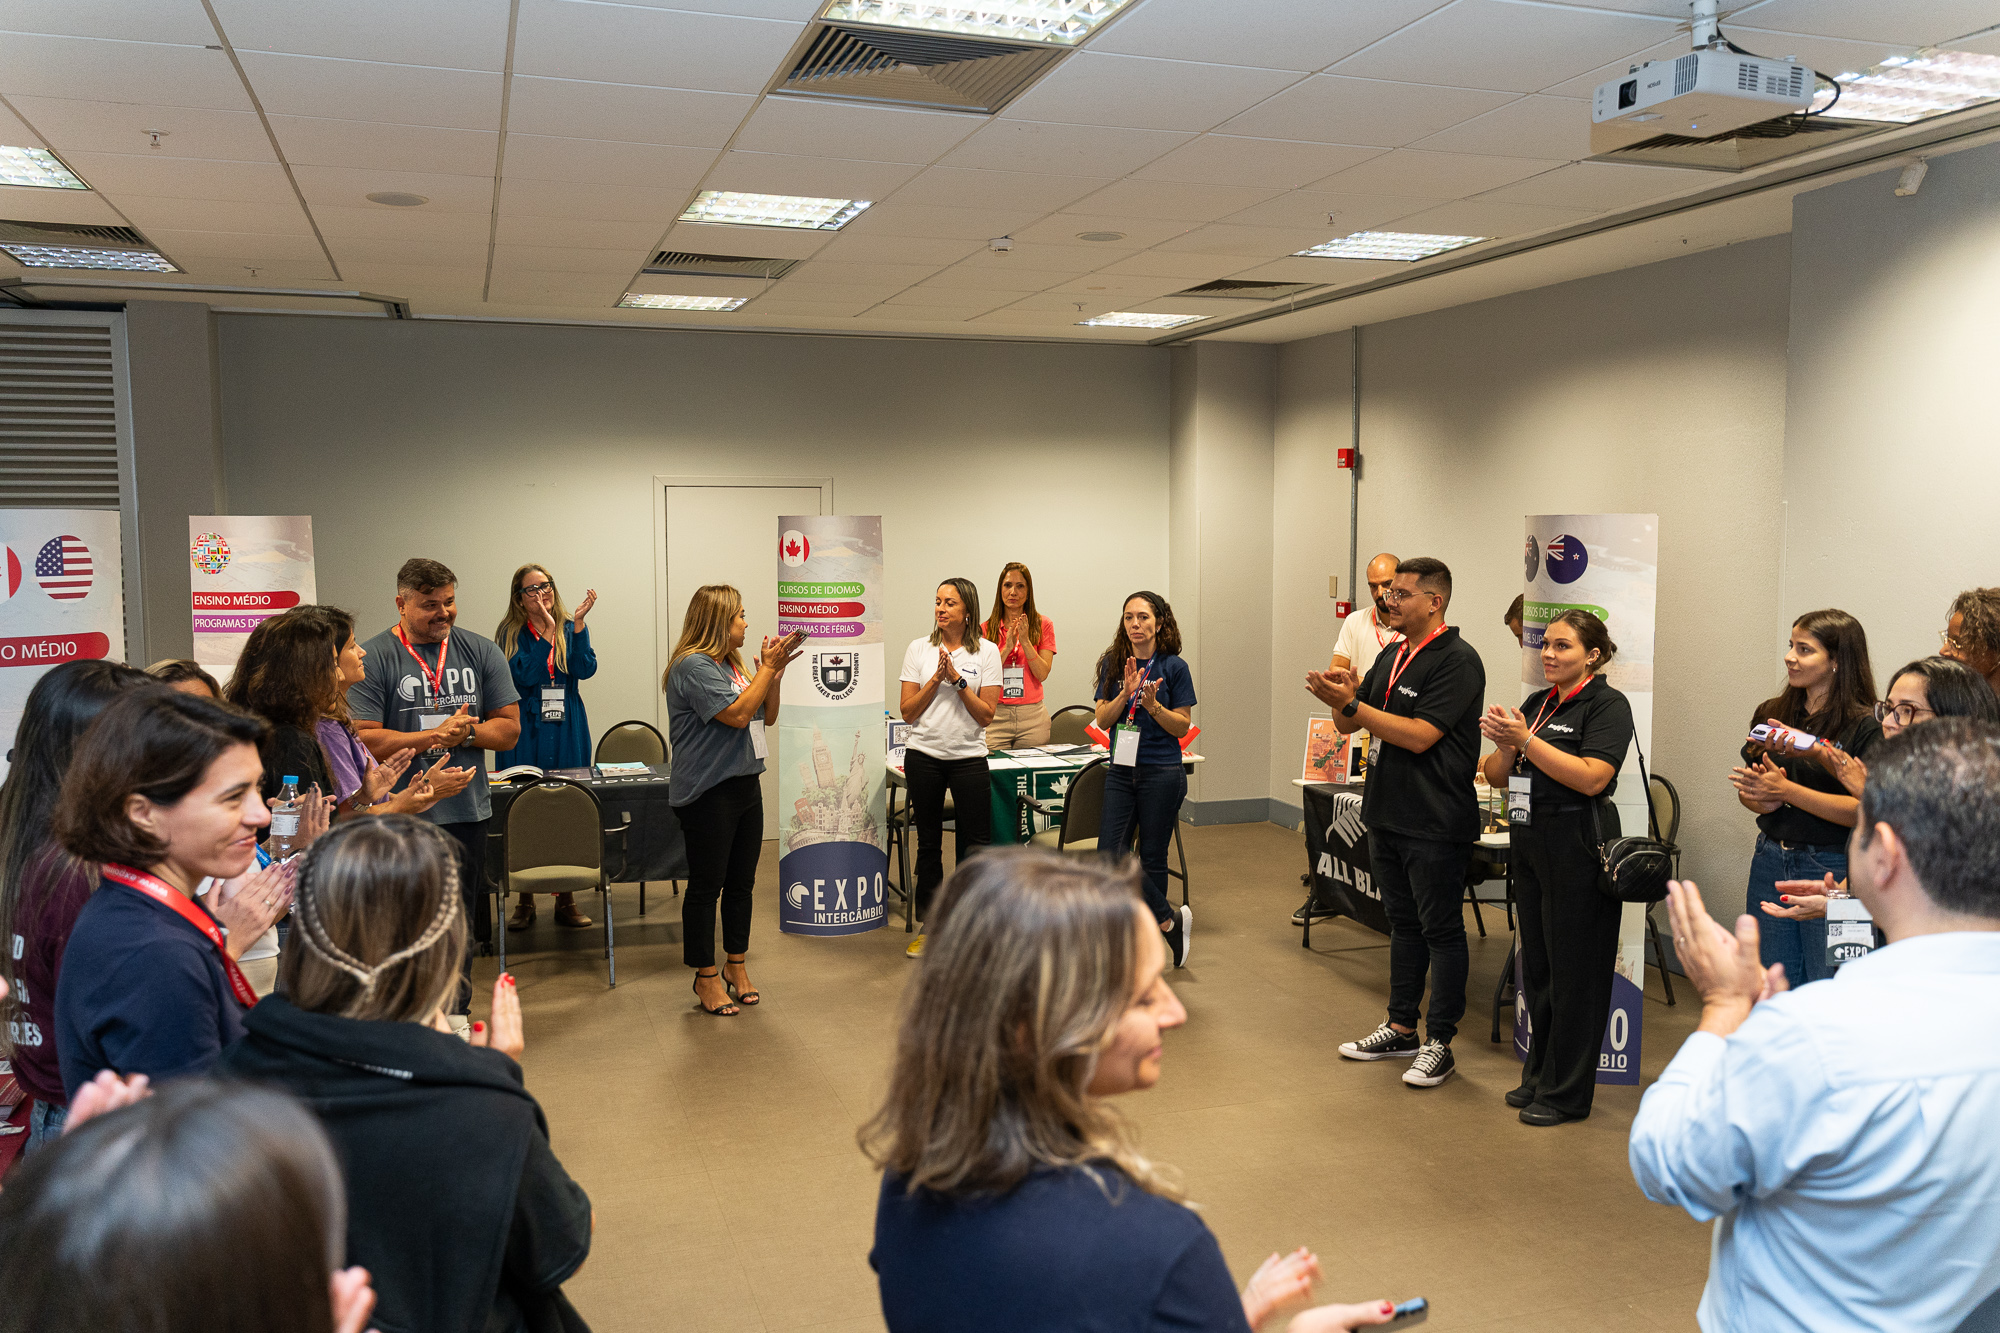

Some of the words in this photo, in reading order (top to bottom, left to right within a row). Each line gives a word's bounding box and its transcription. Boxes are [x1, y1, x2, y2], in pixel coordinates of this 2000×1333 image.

[780, 585, 808, 594] CURSOS
[811, 586, 822, 594] DE
[824, 585, 861, 594] IDIOMAS
[194, 596, 231, 605] ENSINO
[233, 594, 271, 605] MÉDIO
[780, 604, 807, 613] ENSINO
[809, 604, 839, 614] MÉDIO
[1539, 607, 1549, 618] DE
[195, 618, 246, 628] PROGRAMAS
[820, 625, 831, 634] DE
[832, 624, 855, 634] FÉRIAS
[21, 641, 77, 659] MÉDIO
[815, 683, 831, 698] LAKES
[831, 686, 855, 700] COLLEGE
[1016, 774, 1027, 796] THE
[1316, 851, 1353, 886] ALL
[814, 871, 883, 911] EXPO
[814, 904, 884, 924] INTERCÂMBIO
[1844, 945, 1868, 958] EXPO
